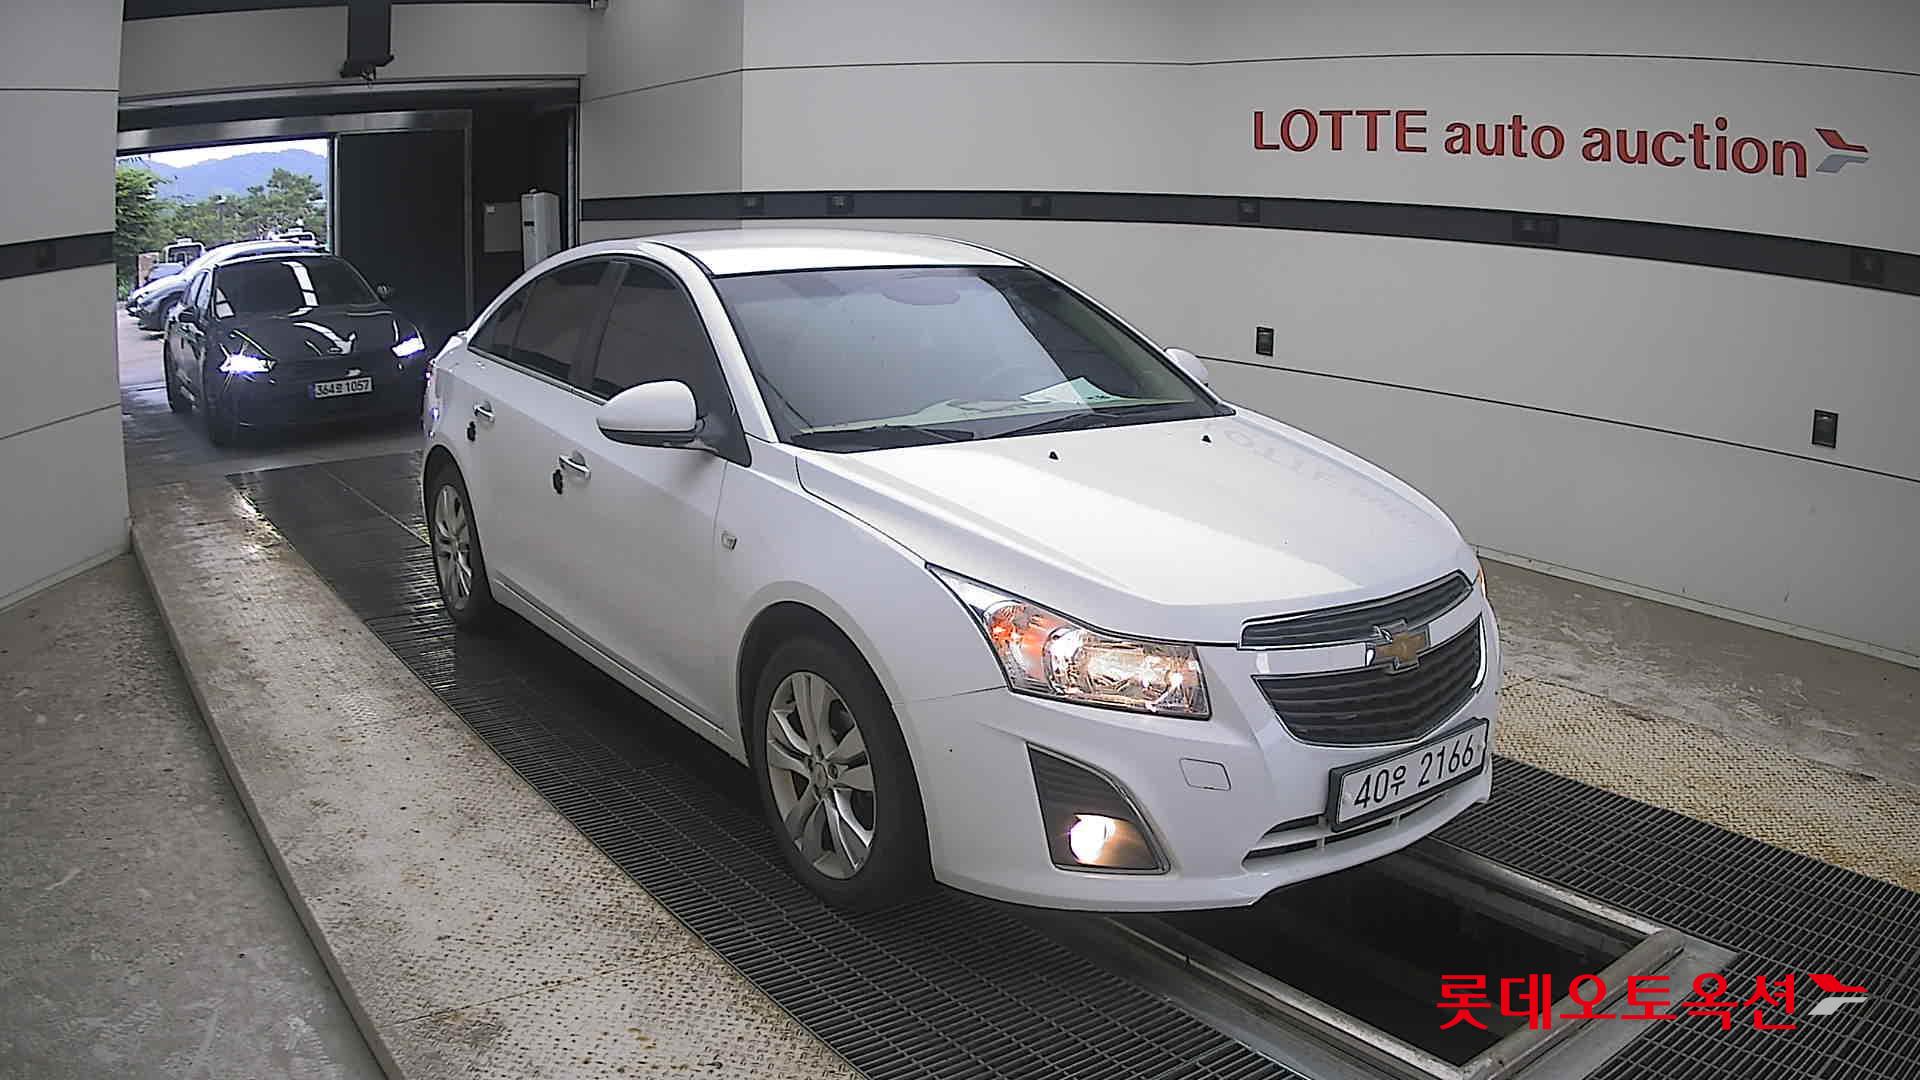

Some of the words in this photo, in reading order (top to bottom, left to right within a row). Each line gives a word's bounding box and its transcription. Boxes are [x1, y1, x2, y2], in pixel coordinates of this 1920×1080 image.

[1253, 109, 1428, 153] LOTTE
[1444, 115, 1565, 159] auto
[1581, 117, 1808, 178] auction
[1354, 765, 1407, 809] 40우
[1418, 734, 1474, 788] 2166
